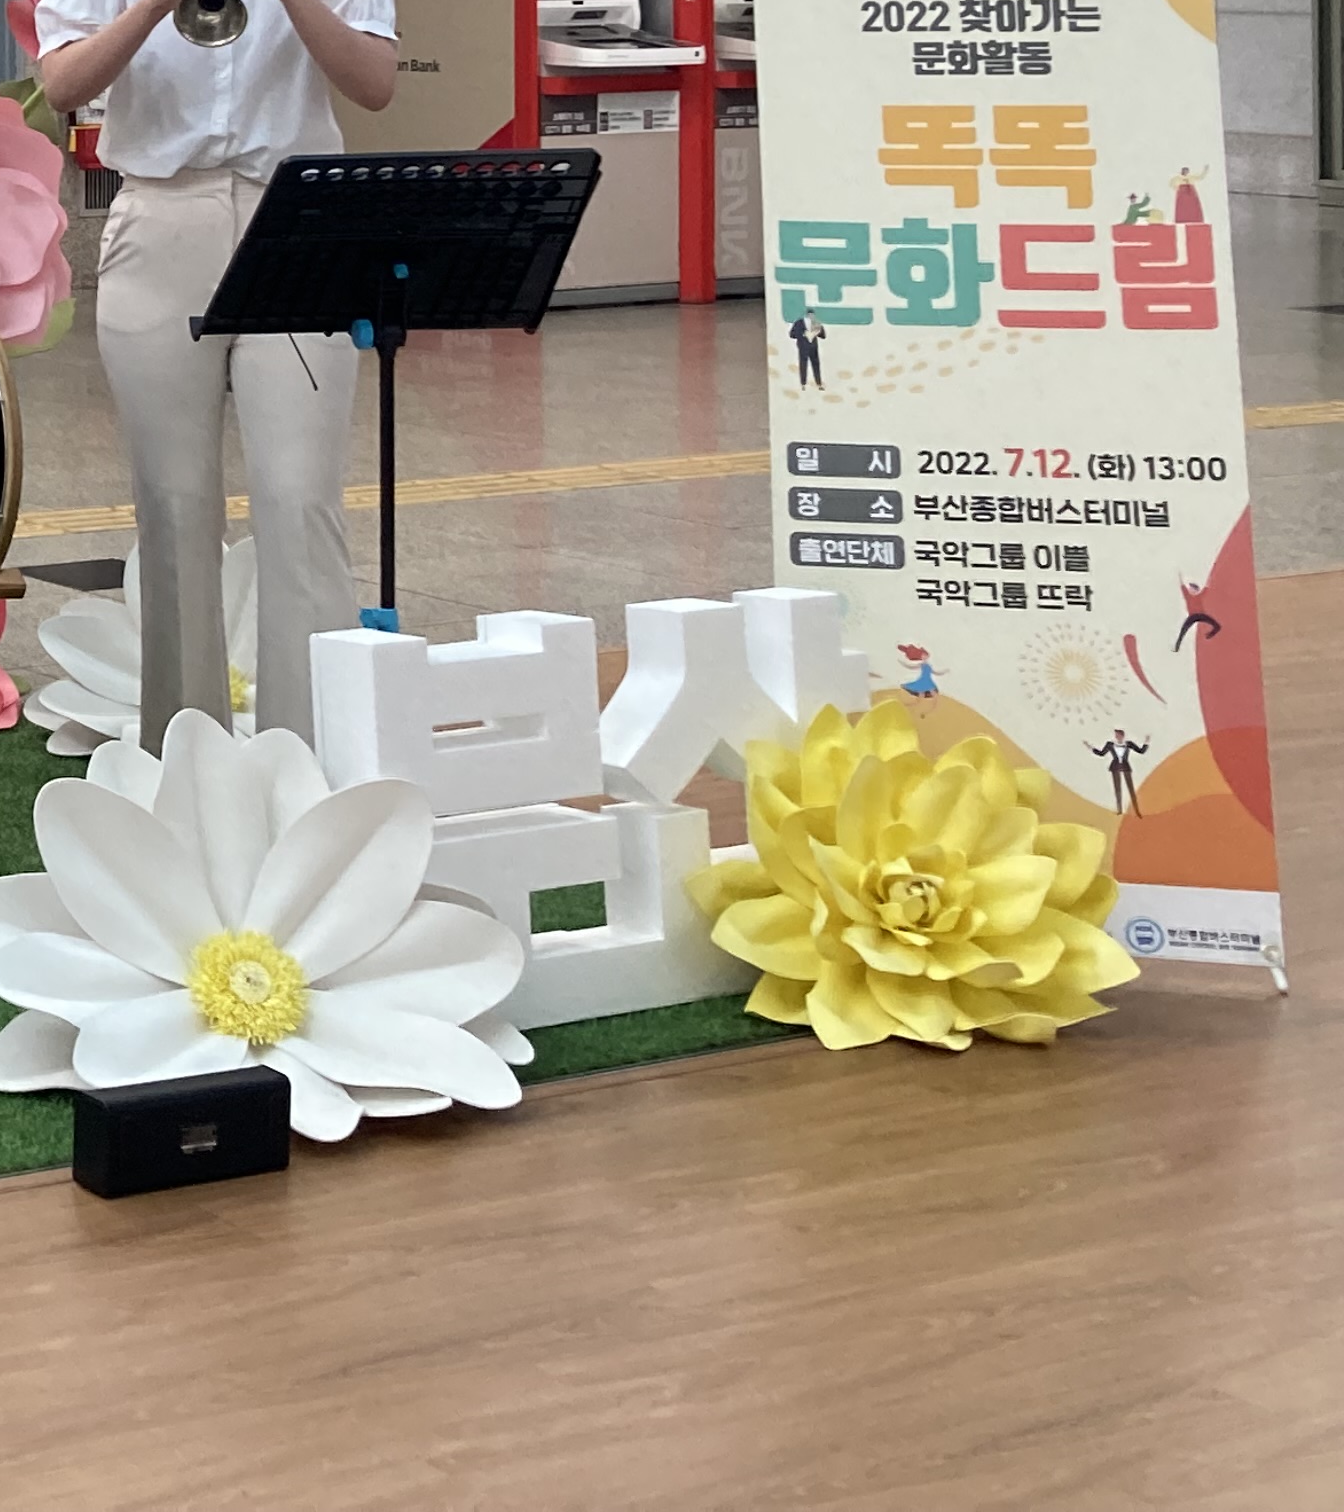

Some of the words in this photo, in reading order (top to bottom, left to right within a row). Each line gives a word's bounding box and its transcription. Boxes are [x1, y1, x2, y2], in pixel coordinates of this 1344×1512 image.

[861, 1, 951, 33] 2022
[959, 0, 1102, 34] 찾아가는
[410, 59, 441, 72] Bank
[912, 41, 1053, 76] 문화활동
[878, 104, 1098, 209] 똑똑
[774, 217, 1220, 331] 문화드림
[917, 450, 998, 476] 2022.
[1087, 454, 1136, 481] (화)
[1143, 455, 1227, 482] 13:00
[913, 495, 1170, 528] 부산종합버스터미널
[798, 538, 895, 567] 출연단체
[914, 540, 1026, 571] 국악그룹
[916, 578, 1027, 609] 국악그룹
[1036, 582, 1094, 612] 뜨락
